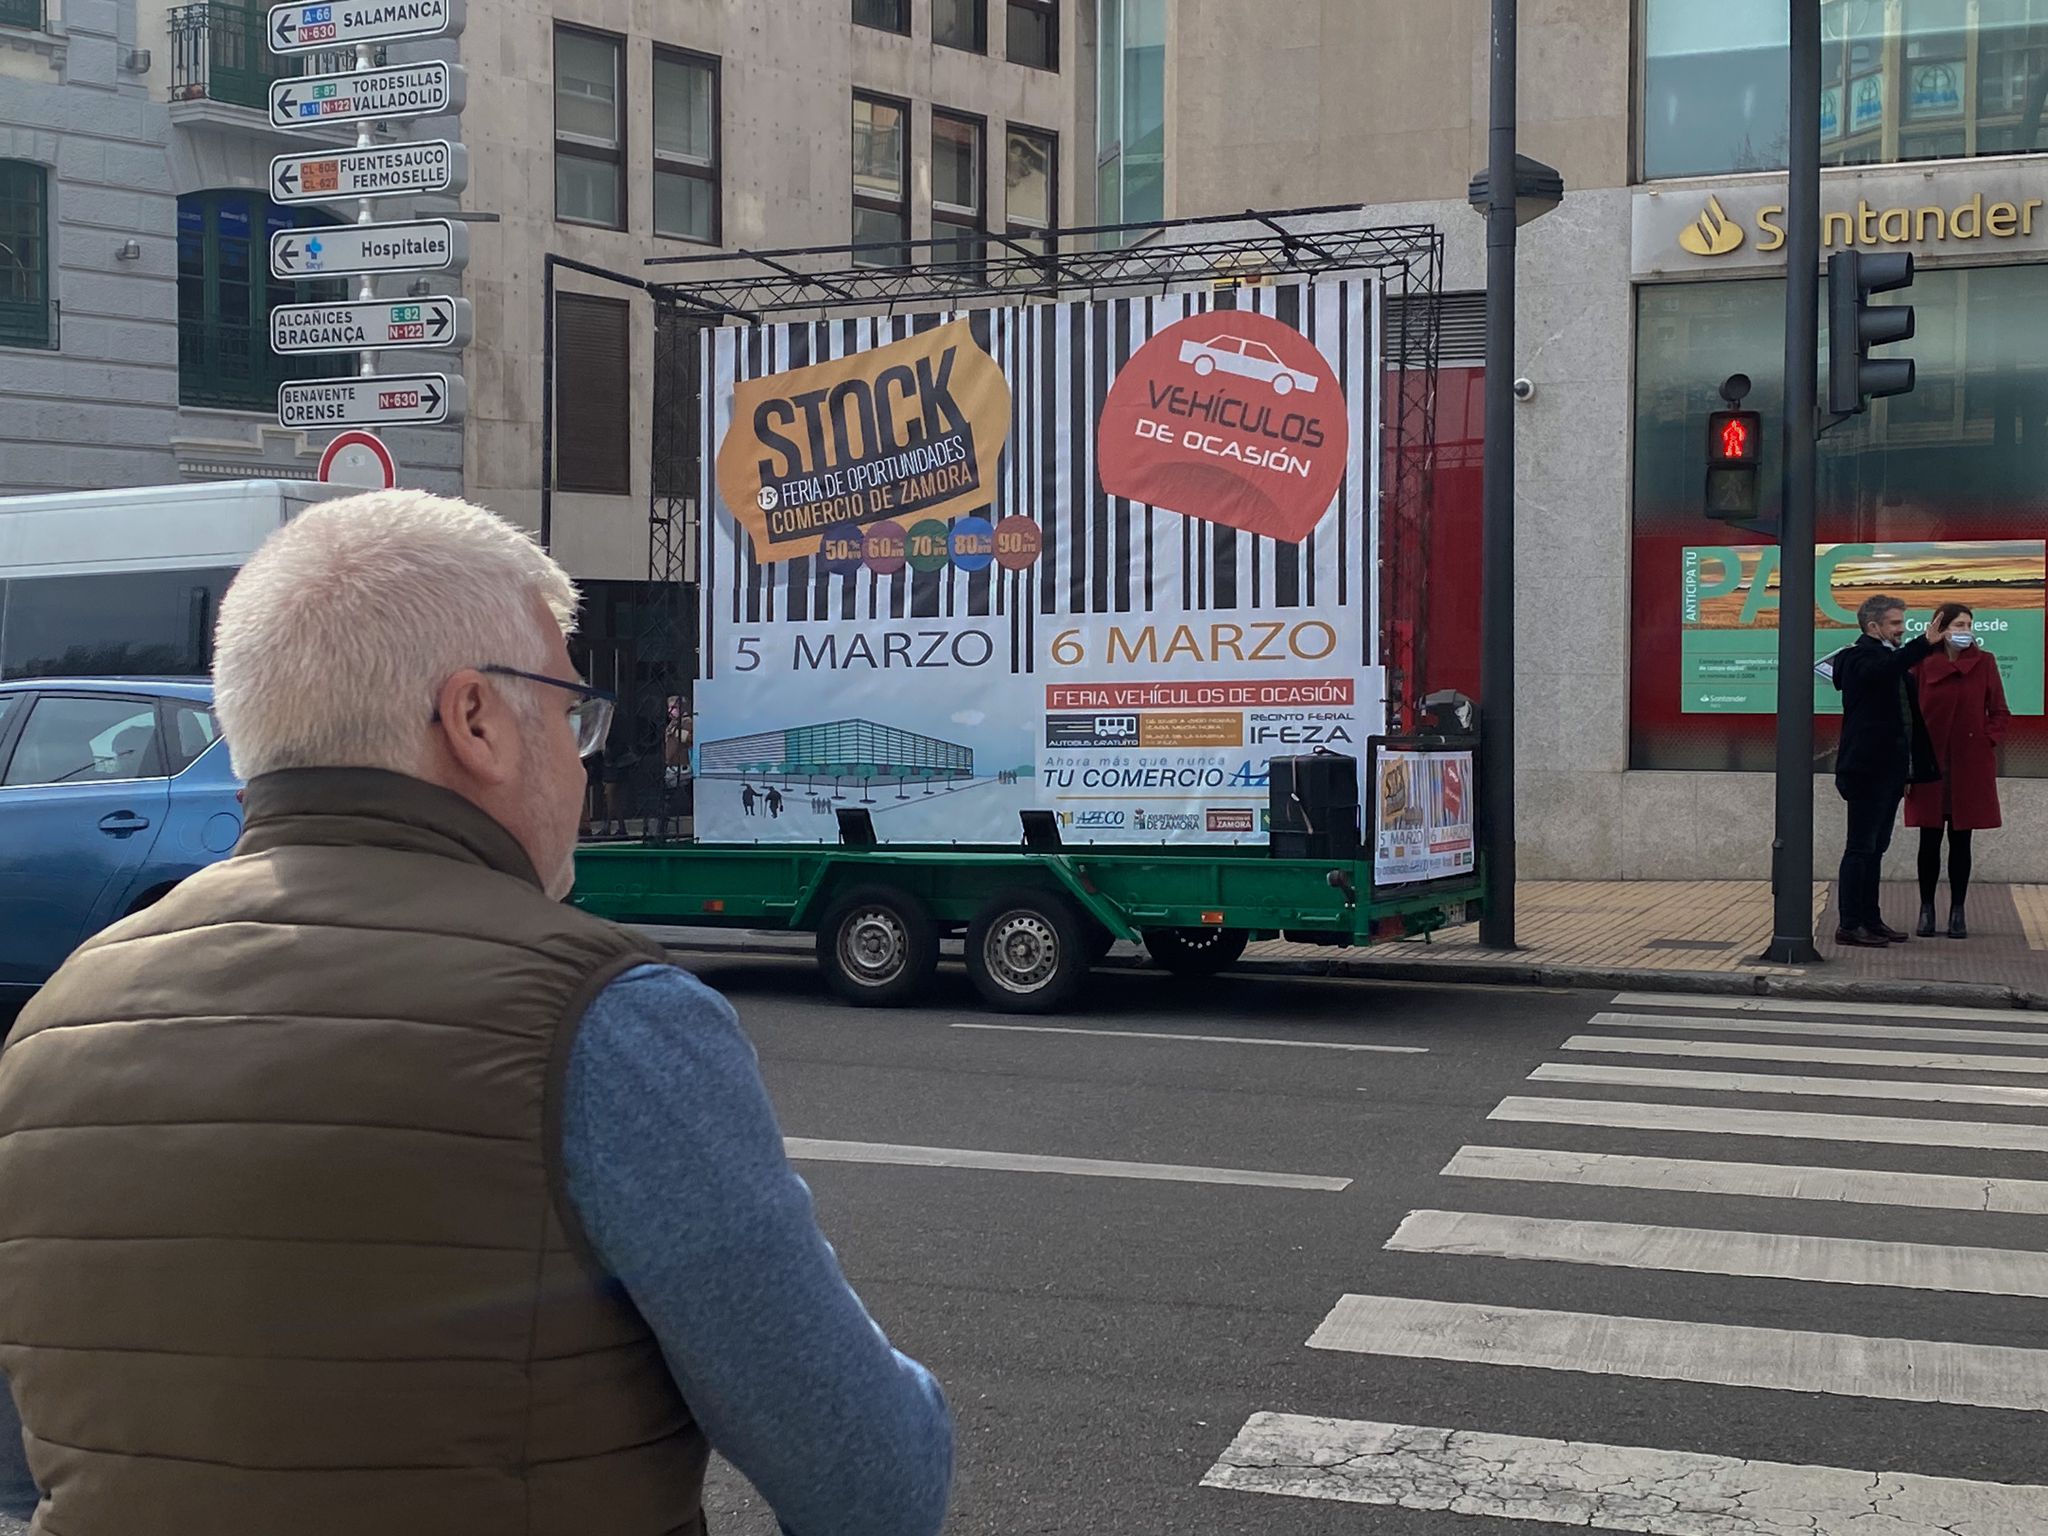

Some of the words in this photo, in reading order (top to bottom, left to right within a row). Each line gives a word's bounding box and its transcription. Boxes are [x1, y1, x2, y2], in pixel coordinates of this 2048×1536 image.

[303, 8, 331, 24] A-66
[343, 1, 442, 27] SALAMANCA
[300, 25, 335, 42] N-630
[353, 71, 442, 93] TORDESILLAS
[313, 85, 336, 98] E-82
[353, 88, 443, 111] VALLADOLID
[301, 104, 319, 116] A-11
[322, 100, 350, 113] N-122
[340, 149, 444, 173] FUENTESAUCO
[353, 167, 445, 188] FERMOSELLE
[1754, 190, 2043, 252] Sntander
[362, 238, 446, 259] Hospitales
[278, 310, 353, 327] ALCAÑICES
[391, 308, 419, 322] E-82
[278, 326, 365, 345] BRAGANÇA
[389, 325, 423, 339] N-122
[285, 387, 356, 403] BENAVENTE
[379, 393, 417, 408] N-630
[285, 404, 346, 420] ORENSE
[753, 345, 970, 480] STOCK
[1149, 379, 1325, 449] VEHÍCULOS
[1135, 418, 1174, 443] DE
[1182, 430, 1311, 478] OCASIÓN
[782, 476, 824, 507] FERIA
[824, 470, 846, 498] DE
[847, 435, 966, 494] OPORTUNIDADES
[772, 492, 864, 535] COMERCIO
[869, 484, 894, 514] DE
[900, 461, 973, 505] ZAMORA
[1686, 551, 1697, 563] TU
[1686, 566, 1698, 621] ANTICIPA
[735, 637, 761, 671] 5
[792, 629, 994, 670] MARZO
[1051, 629, 1084, 665] 6
[1106, 620, 1337, 664] MARZO
[1052, 690, 1110, 706] FERIA
[1114, 683, 1225, 705] VEHÍCULOS
[1229, 687, 1256, 703] DE
[1260, 681, 1348, 703] OCASIÓN
[1250, 713, 1303, 721] RECINTO
[1307, 712, 1354, 721] FERIAL
[1250, 726, 1353, 744] IFEZA
[1046, 756, 1090, 766] Ahora
[1100, 756, 1130, 766] más
[1139, 757, 1168, 768] que
[1177, 756, 1225, 766] nunca
[1043, 770, 1074, 787] TU
[1083, 769, 1224, 788] COMERCIO
[1076, 811, 1125, 825] AZECO
[1146, 813, 1200, 822] AYUNTAMIENTO
[1147, 821, 1158, 829] DE
[1159, 821, 1200, 829] ZAMORA
[1216, 821, 1252, 829] ZAMORA
